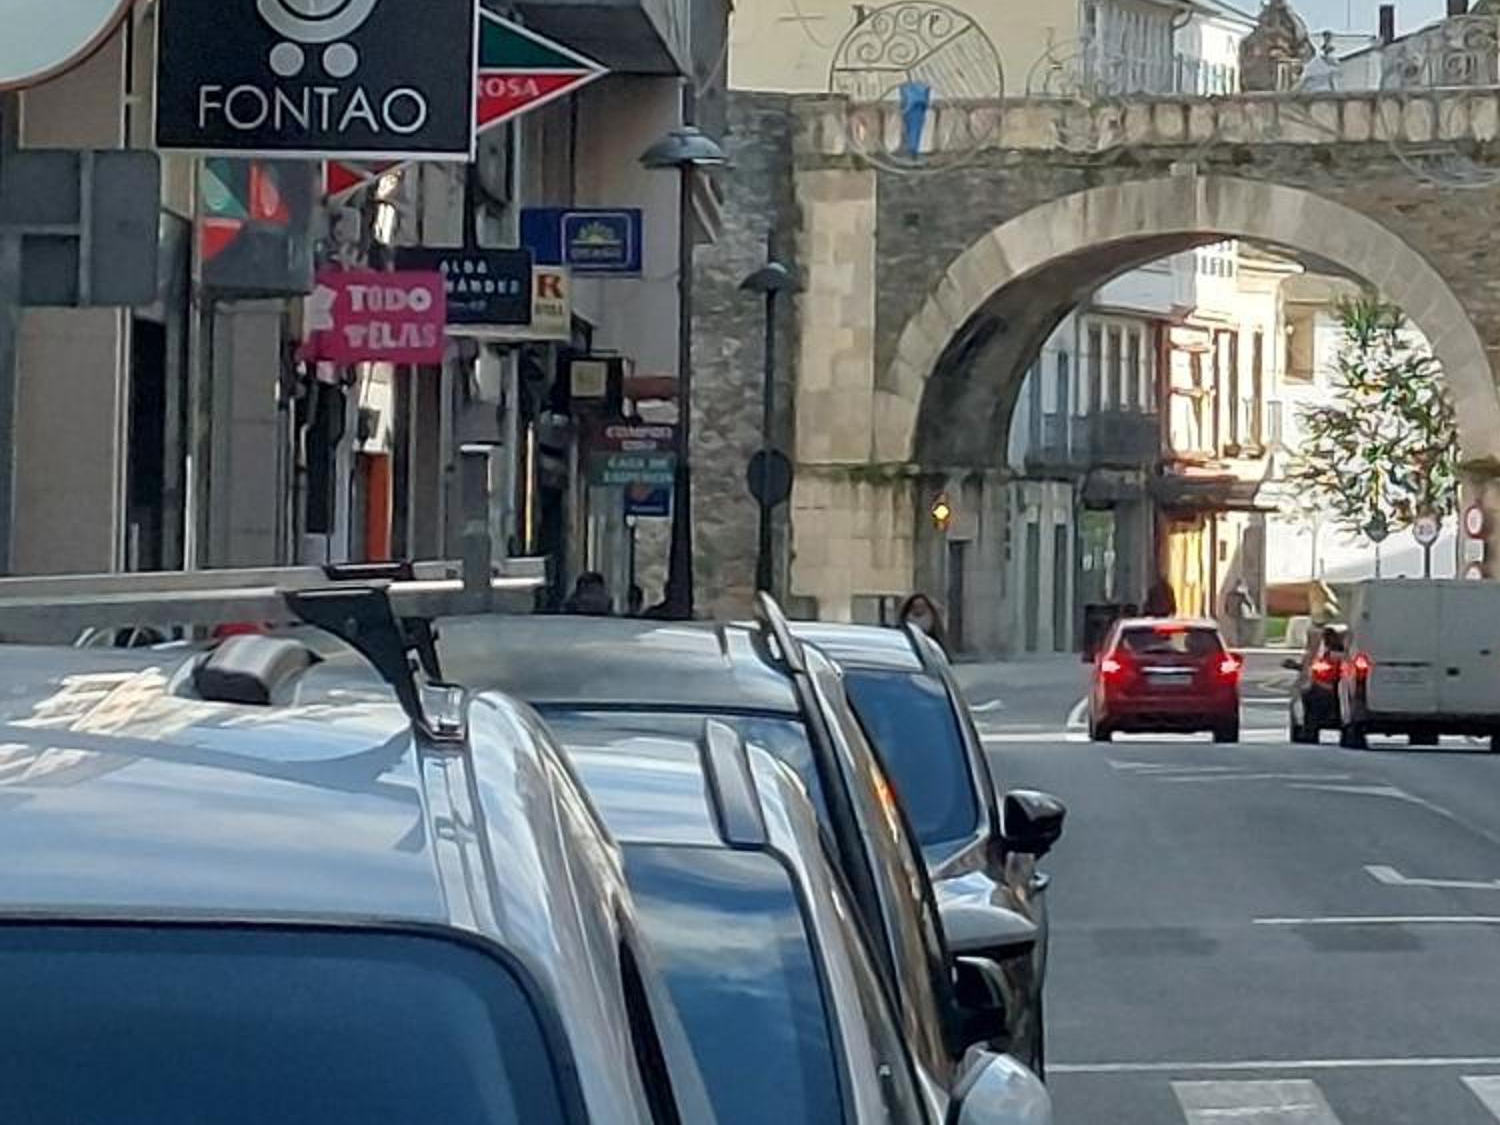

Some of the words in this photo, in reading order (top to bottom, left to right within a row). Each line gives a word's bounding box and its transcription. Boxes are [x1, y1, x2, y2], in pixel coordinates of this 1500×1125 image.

[198, 84, 428, 134] FONTAO
[345, 284, 432, 313] TODO
[344, 320, 438, 349] TELAS
